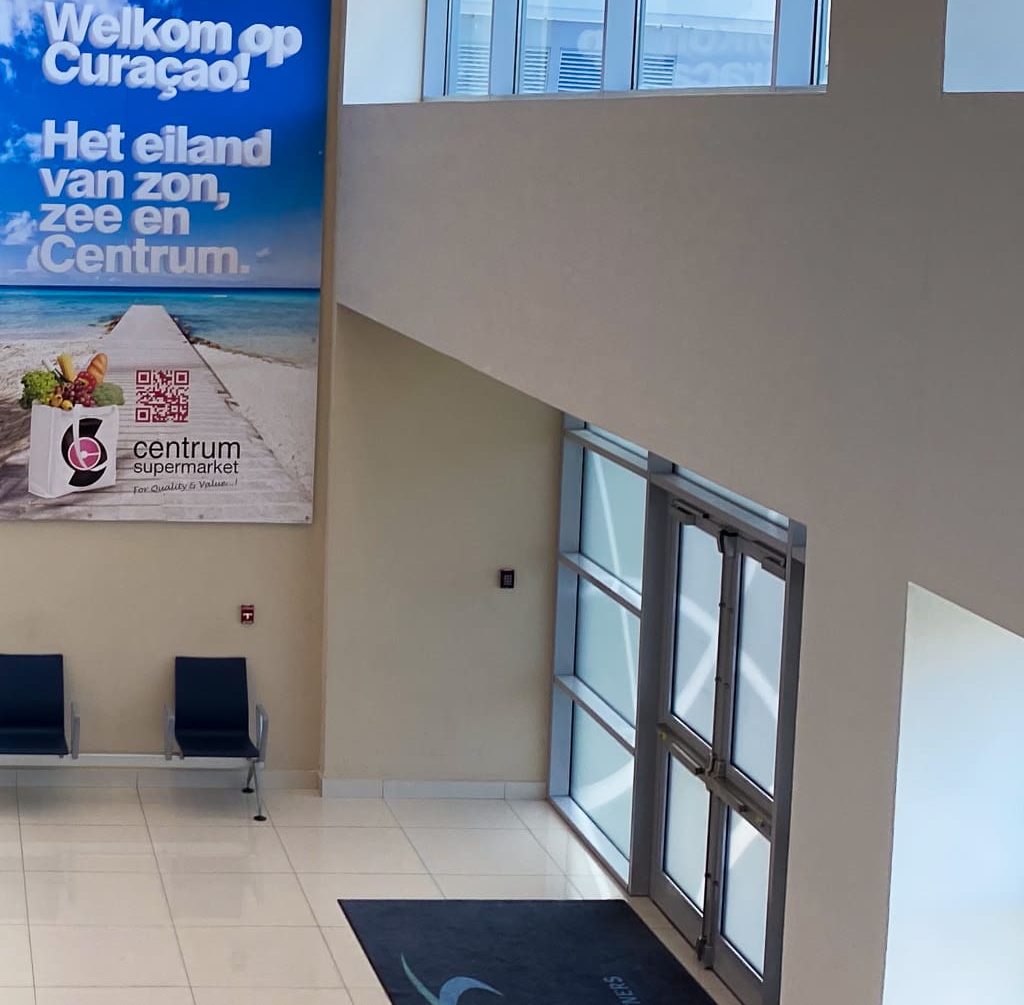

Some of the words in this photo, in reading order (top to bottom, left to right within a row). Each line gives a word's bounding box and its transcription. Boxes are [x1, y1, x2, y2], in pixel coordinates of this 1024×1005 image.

[44, 1, 233, 55] Welkom
[238, 23, 303, 68] op
[42, 41, 251, 101] Curaçao!
[41, 119, 125, 162] Het
[132, 124, 272, 167] eiland
[39, 168, 124, 199] van
[132, 171, 230, 211] zon,
[39, 203, 123, 233] zee
[132, 205, 190, 235] en
[38, 234, 251, 274] Centrum.
[133, 437, 241, 459] centrum
[133, 460, 239, 476] supermarket
[133, 486, 147, 494] For
[150, 482, 188, 493] Quality
